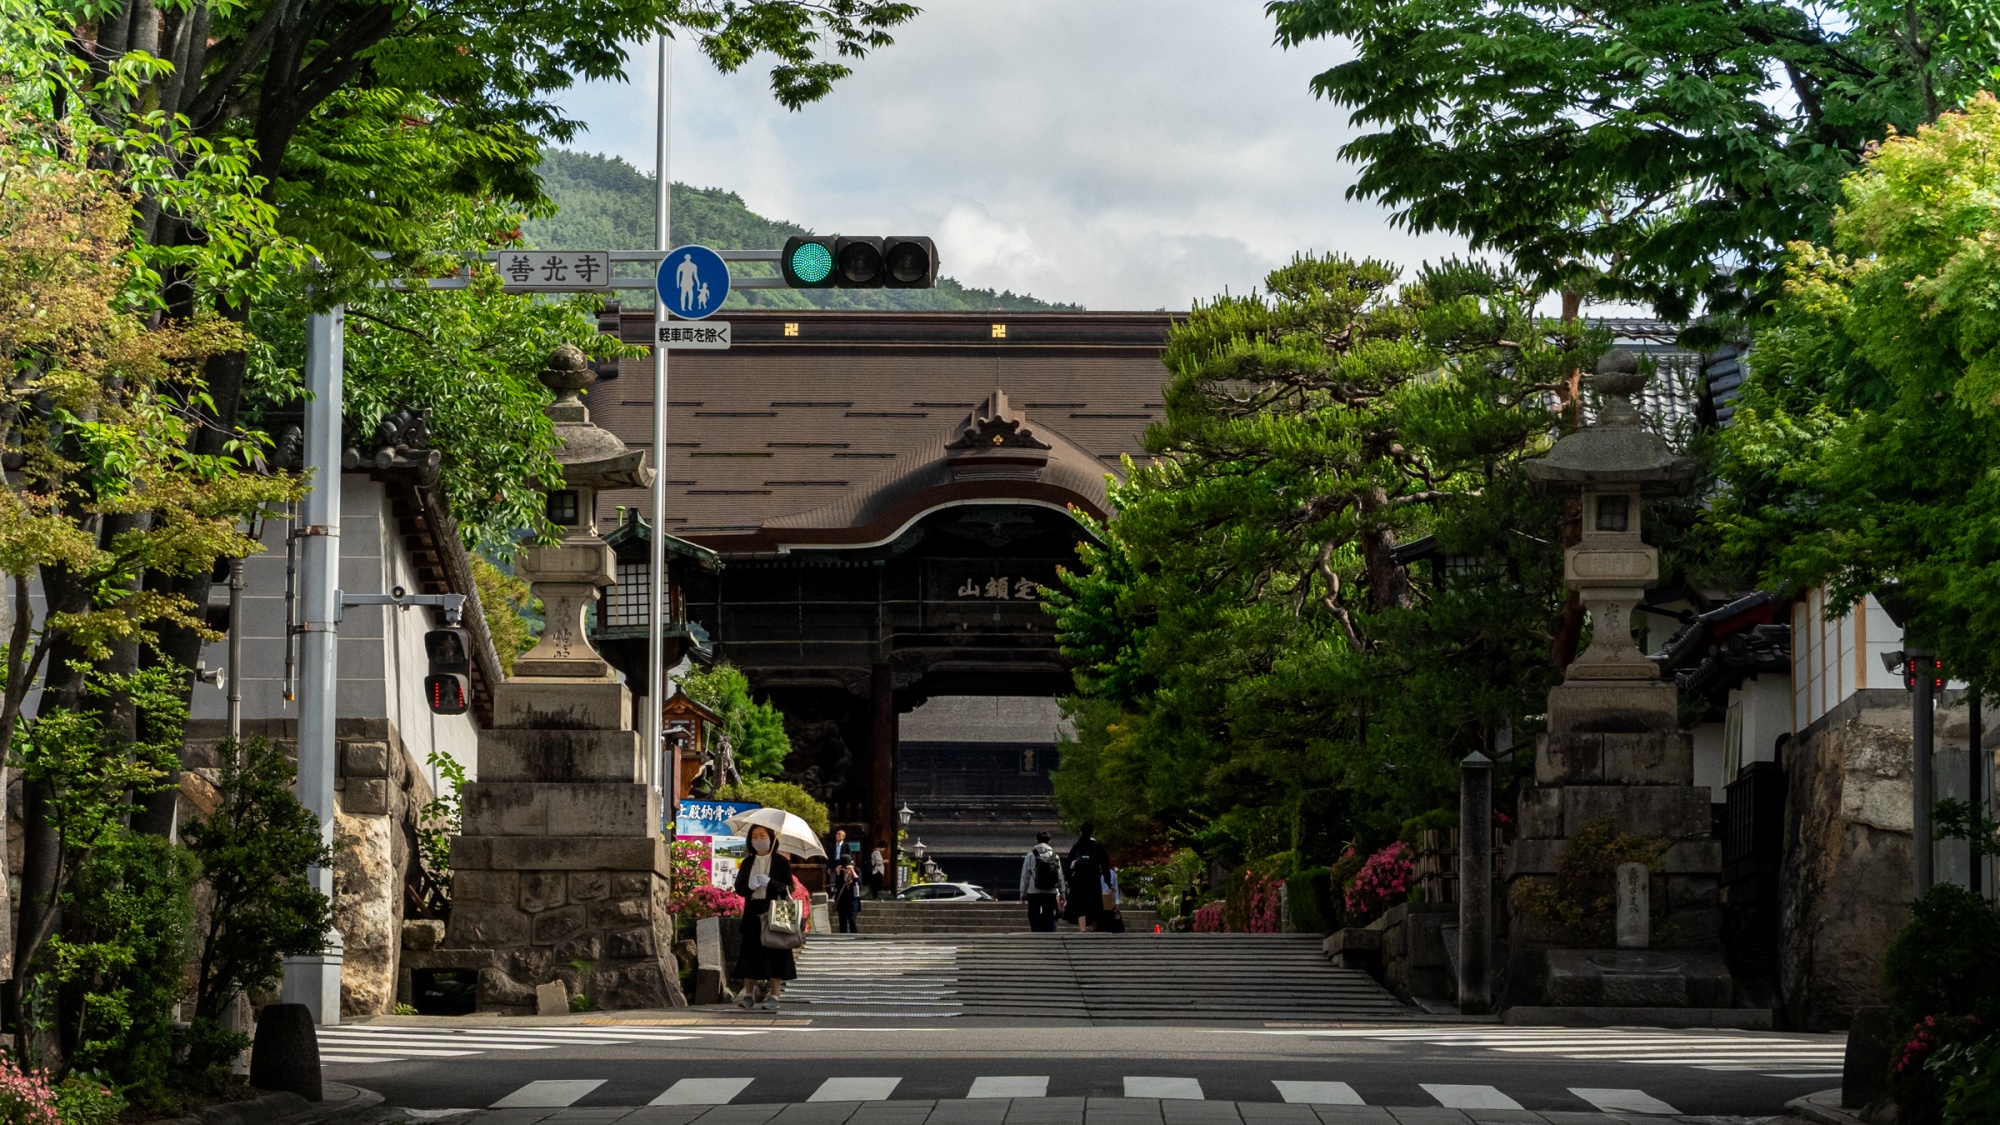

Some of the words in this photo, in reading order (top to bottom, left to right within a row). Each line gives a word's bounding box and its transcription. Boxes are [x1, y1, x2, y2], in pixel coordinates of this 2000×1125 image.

[506, 254, 601, 283] 善光寺
[658, 327, 727, 343] 軽車両を除く
